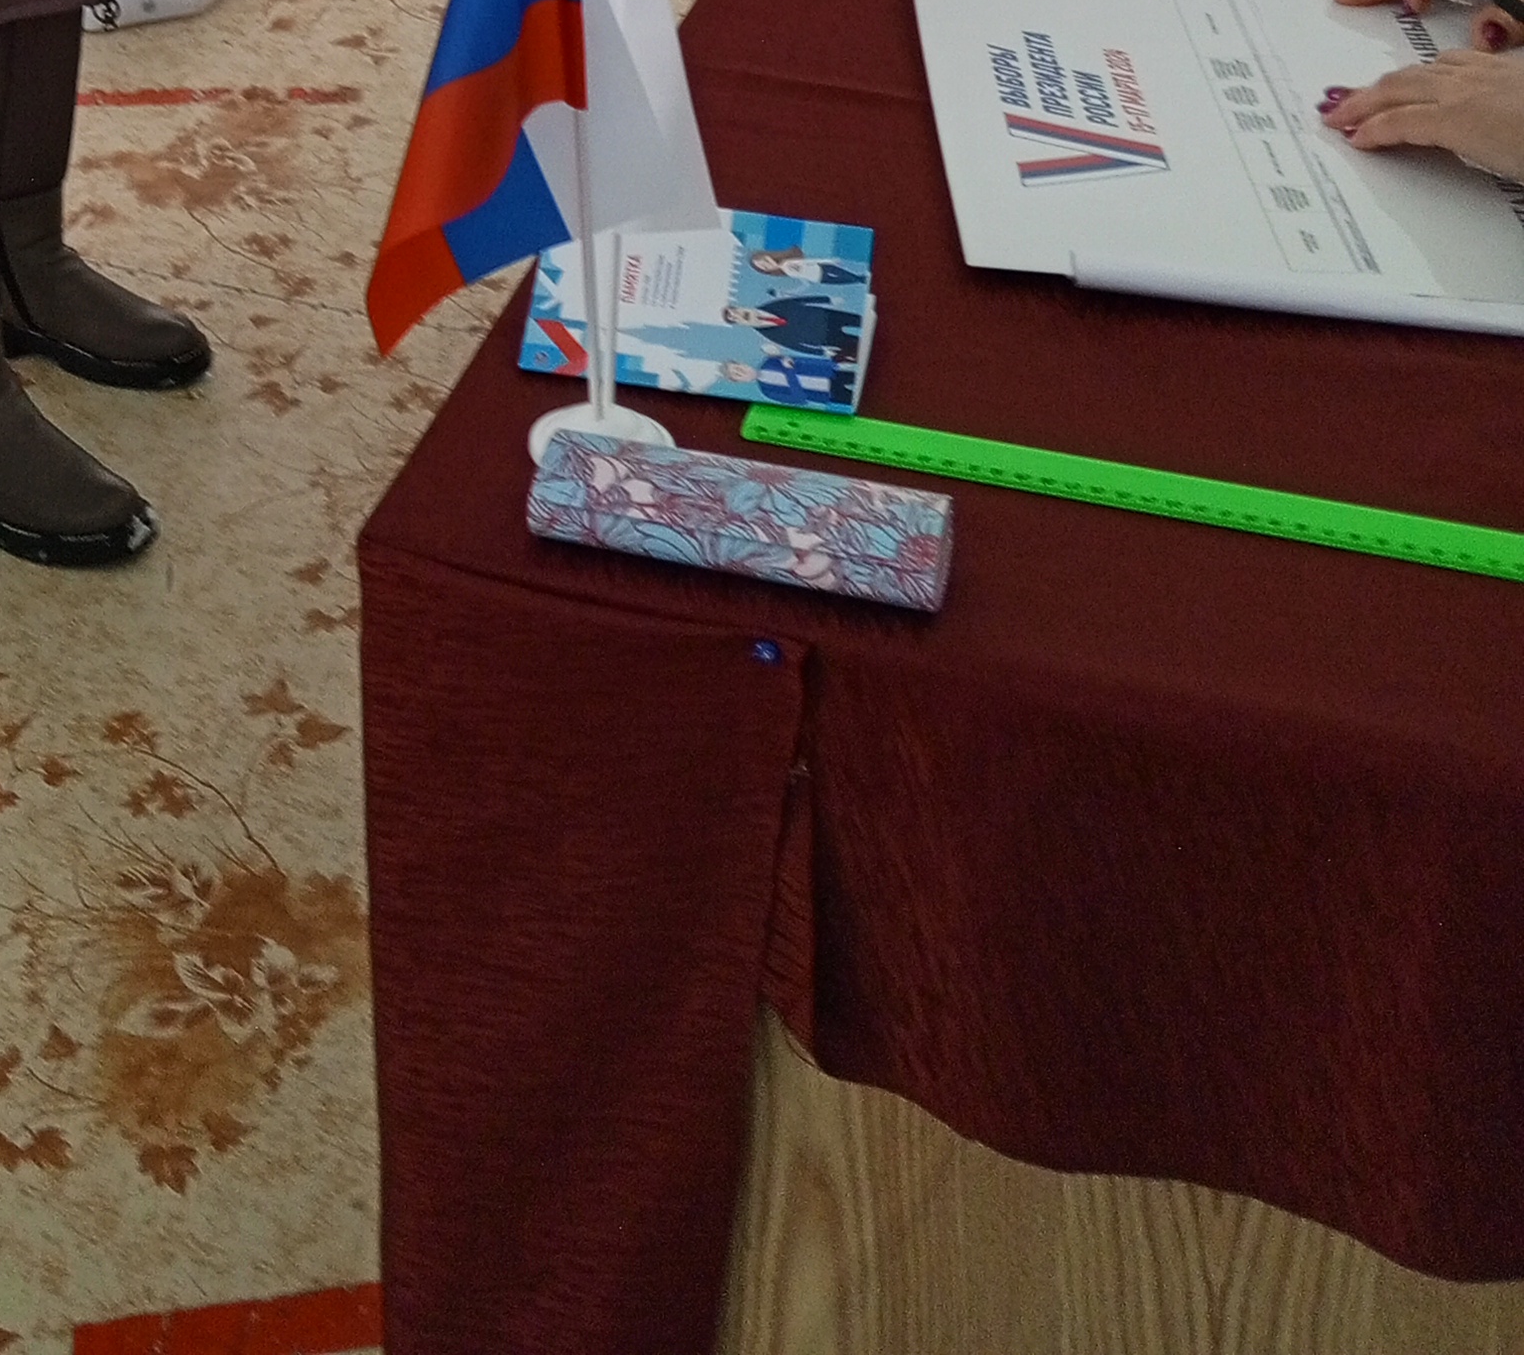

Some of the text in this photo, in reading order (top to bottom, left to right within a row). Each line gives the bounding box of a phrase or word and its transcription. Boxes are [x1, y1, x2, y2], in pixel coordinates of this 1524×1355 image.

[986, 43, 1032, 110] ВЫБОРЫ
[1021, 30, 1075, 119] ПРЕЗИДЕНТА
[1072, 69, 1119, 128] РОССИИ
